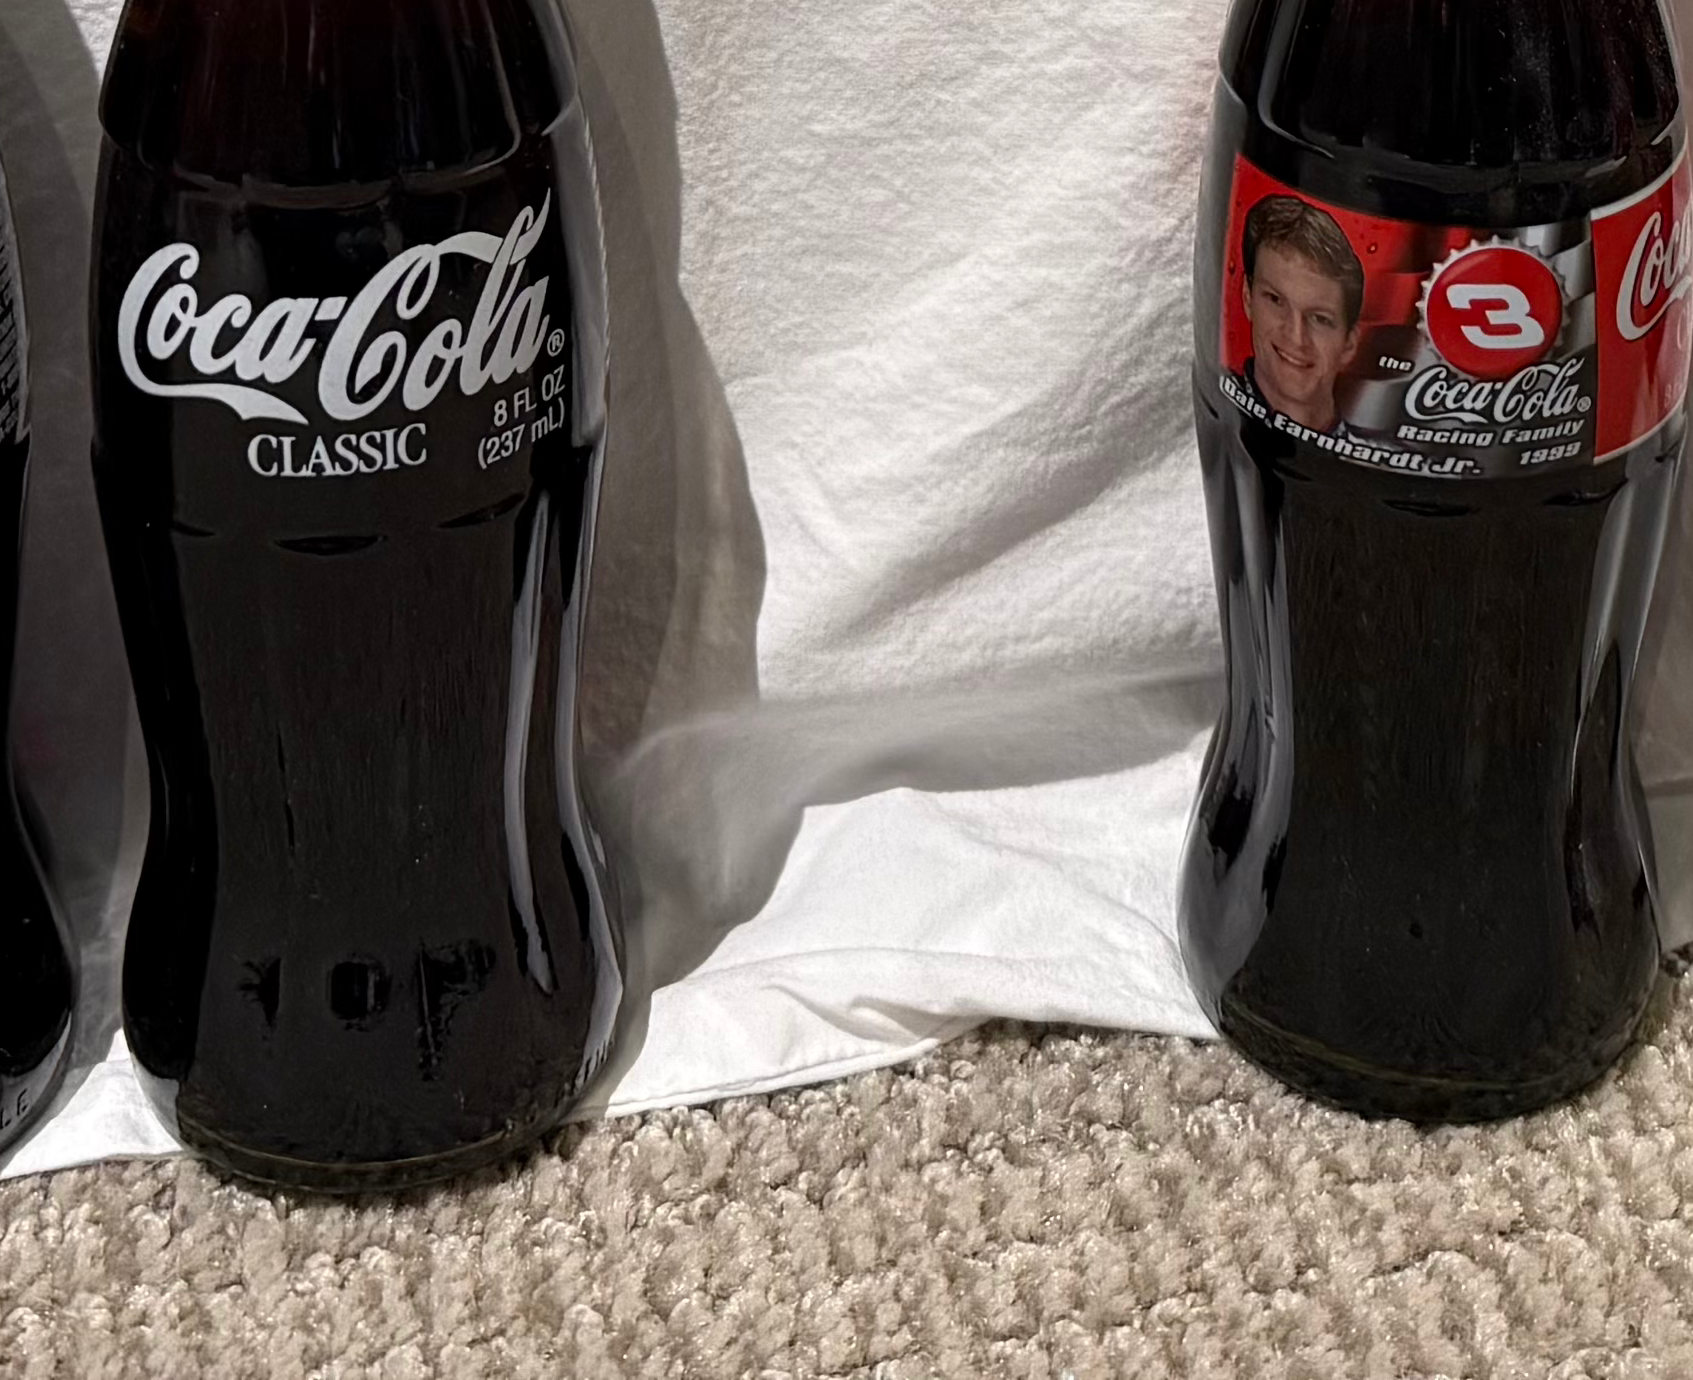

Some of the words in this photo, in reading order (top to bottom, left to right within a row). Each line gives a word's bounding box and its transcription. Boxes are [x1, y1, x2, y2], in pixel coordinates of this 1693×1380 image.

[117, 187, 551, 426] Coca-Cola
[1446, 283, 1545, 350] 3
[493, 398, 509, 428] 8
[513, 386, 538, 421] FL
[542, 364, 566, 402] OZ
[1379, 355, 1412, 372] the
[1405, 356, 1587, 425] Coca-Cola
[247, 423, 427, 478] CLASSIC
[477, 426, 523, 470] (237
[531, 398, 566, 442] mL)
[1220, 374, 1273, 430] Dale
[1273, 412, 1423, 474] Earnhardt
[1426, 452, 1483, 477] Jr.
[1398, 423, 1493, 447] Racing
[1502, 418, 1585, 447] Family
[1519, 440, 1581, 466] 1999
